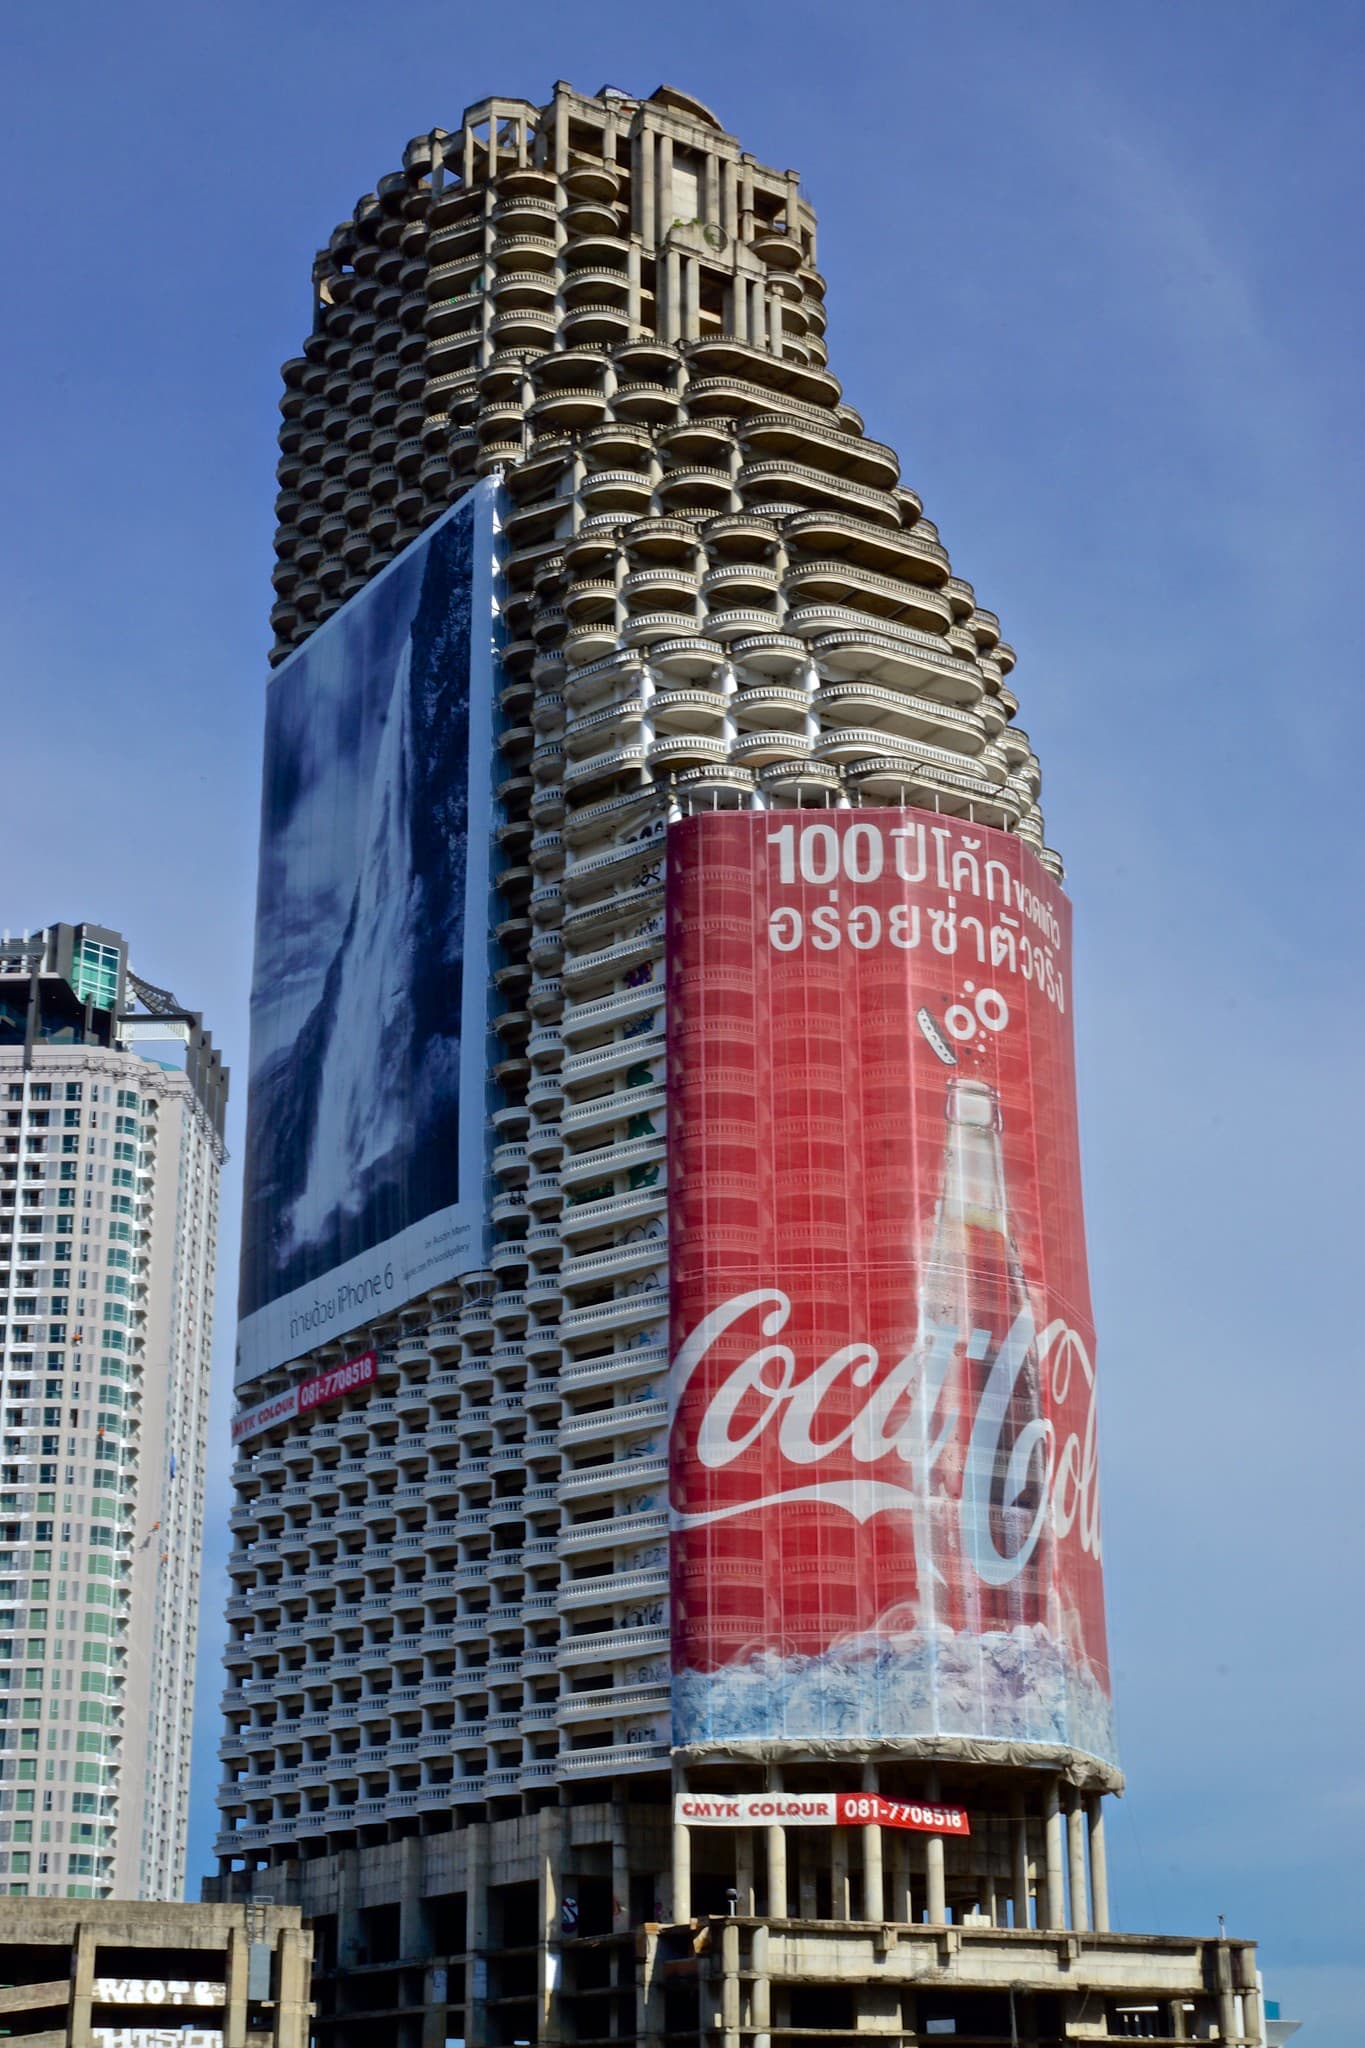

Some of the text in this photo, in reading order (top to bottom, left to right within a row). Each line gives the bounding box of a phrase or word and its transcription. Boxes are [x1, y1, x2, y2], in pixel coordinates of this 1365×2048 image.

[338, 1274, 382, 1313] iPhone
[384, 1261, 394, 1290] 6
[682, 1799, 962, 1828] CMYK COLOUR 081-7708518
